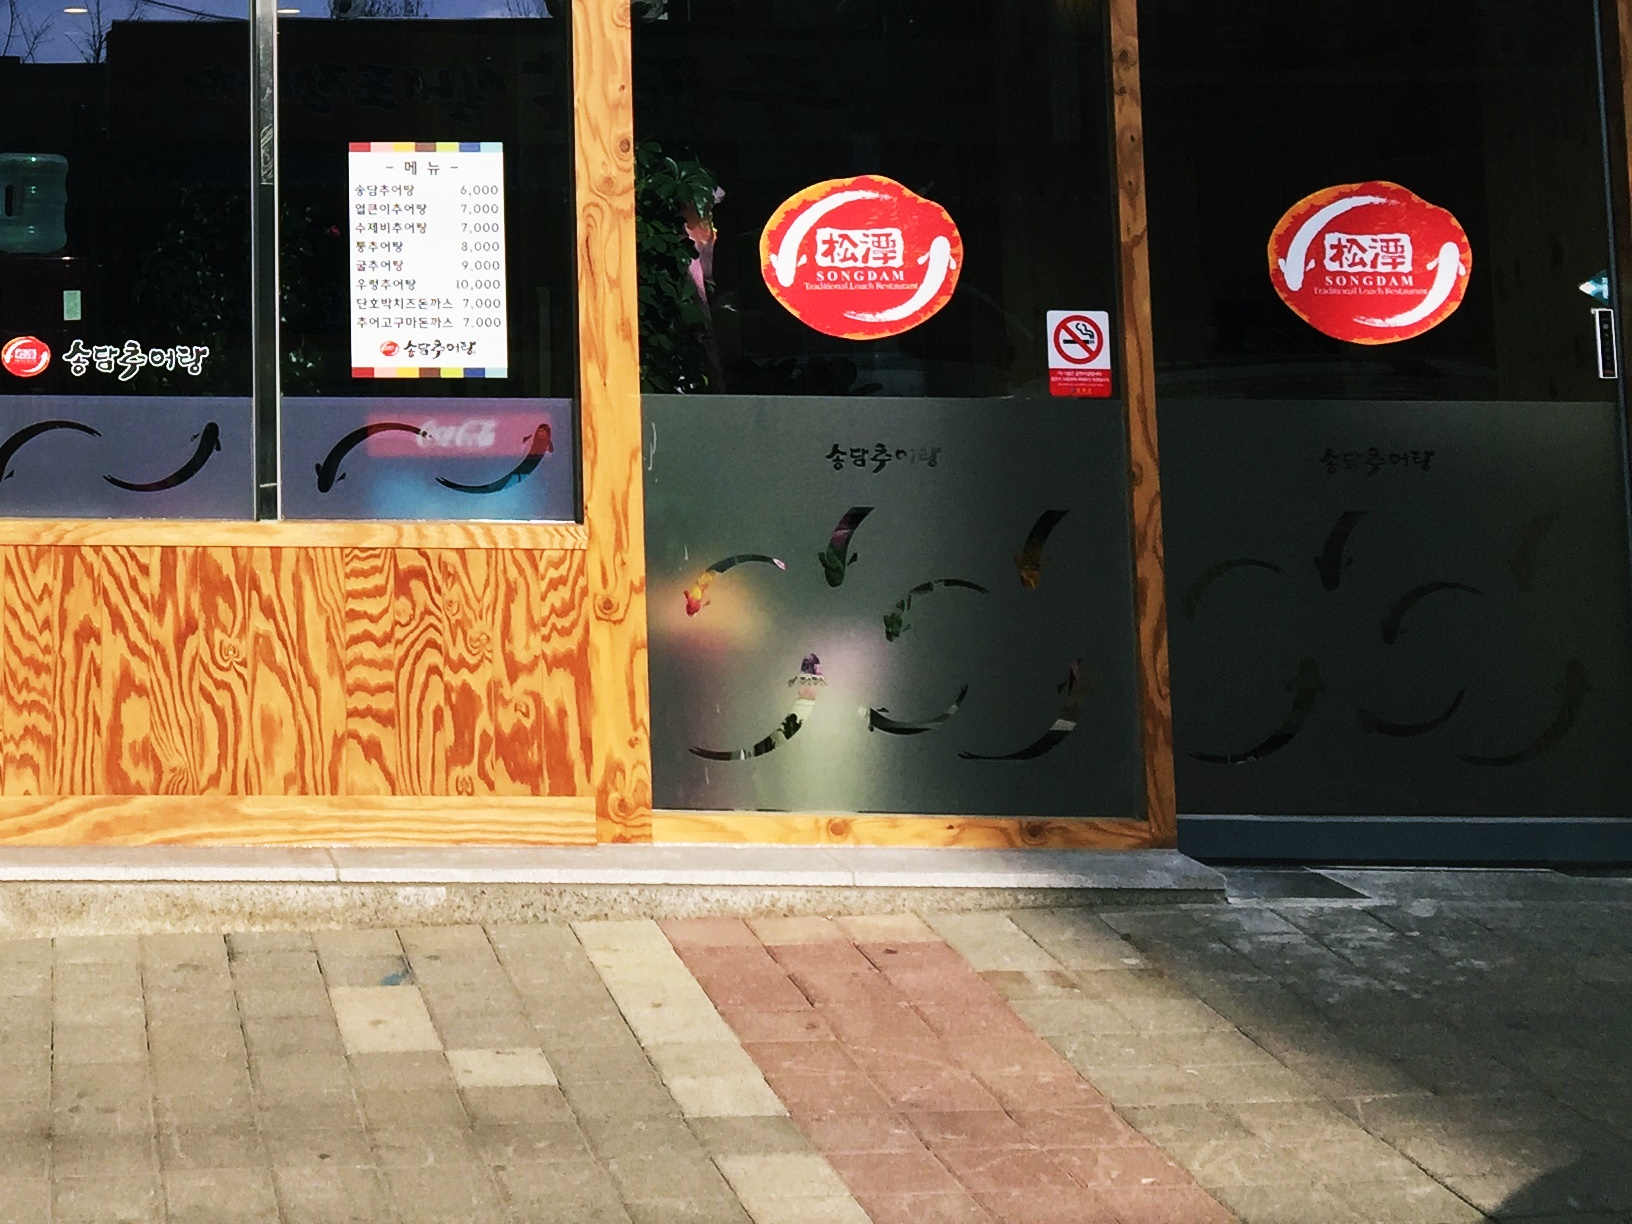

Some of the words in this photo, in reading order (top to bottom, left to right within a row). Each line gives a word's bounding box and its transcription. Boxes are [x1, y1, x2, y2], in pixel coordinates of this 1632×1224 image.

[354, 184, 415, 197] 송담추어탕
[460, 184, 499, 197] 6,000
[354, 203, 428, 216] 얼큰이추어탕
[460, 203, 499, 215] 7,000
[355, 222, 428, 235] 수제비추어탕
[461, 222, 500, 234] 7,000
[356, 241, 404, 254] 통추어탕
[461, 241, 500, 253] 8,000
[356, 260, 404, 272] 굴추어탕
[461, 260, 501, 272] 9,000
[815, 270, 905, 282] SONGDAM
[1324, 275, 1414, 287] SONGDAM
[455, 279, 501, 292] 10,000
[356, 297, 454, 310] 단호박치즈돈까스
[462, 298, 501, 310] 7,000
[356, 316, 454, 329] 추어고구마돈까스
[463, 317, 502, 328] 7,000
[403, 338, 477, 360] 송담추어탕
[62, 339, 210, 382] 송담추어탕
